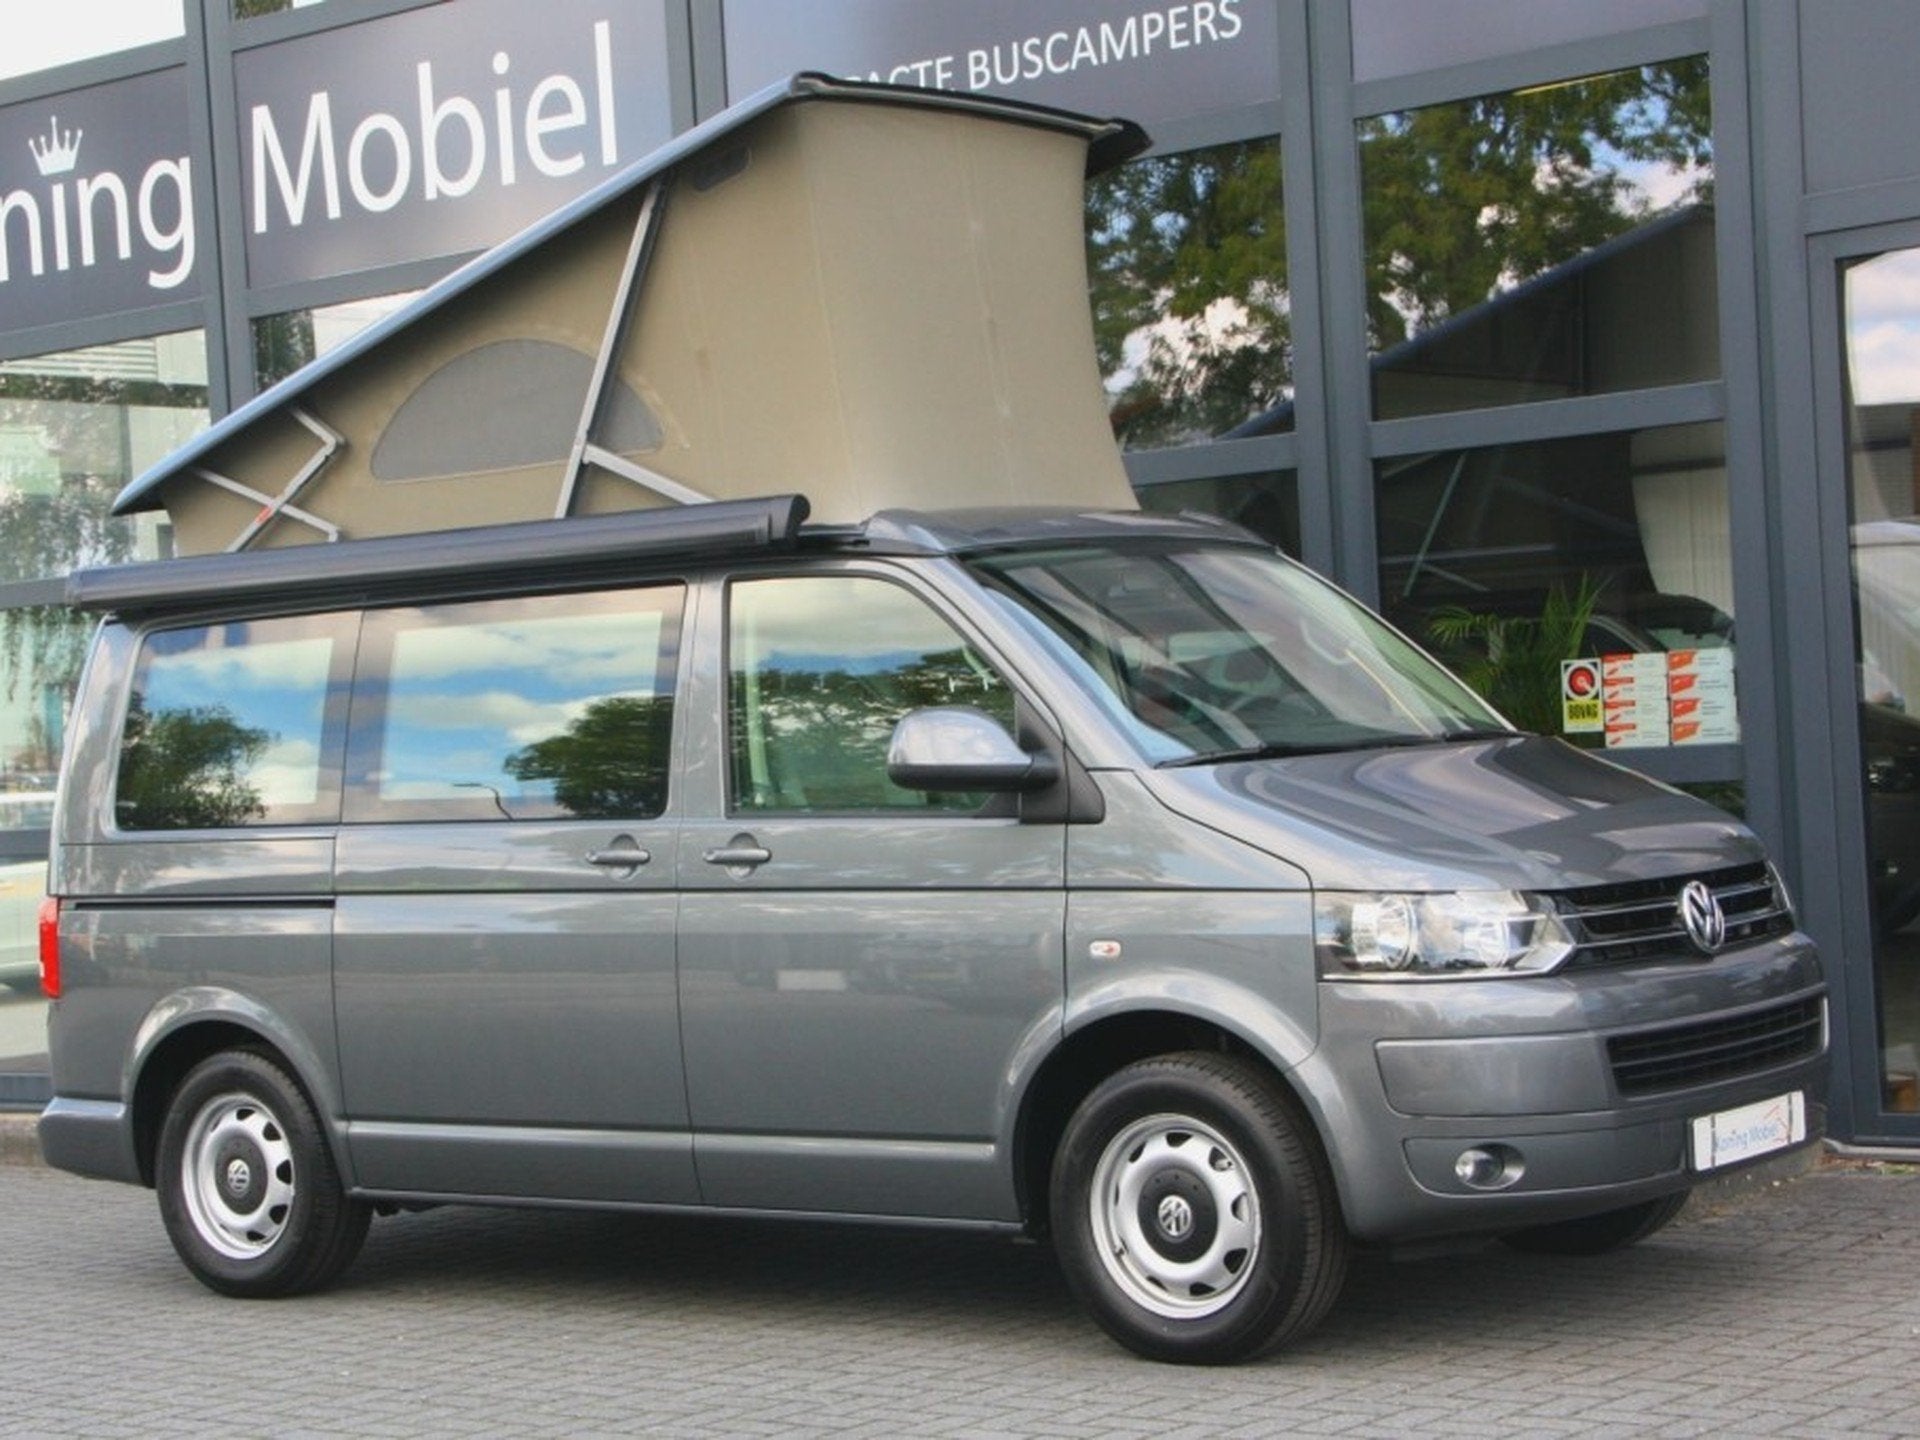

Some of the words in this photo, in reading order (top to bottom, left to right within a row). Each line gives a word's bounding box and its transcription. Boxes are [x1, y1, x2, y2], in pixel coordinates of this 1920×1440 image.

[968, 0, 1242, 90] BUSCAMPERS
[0, 156, 195, 289] ning
[251, 21, 618, 234] Mobiel
